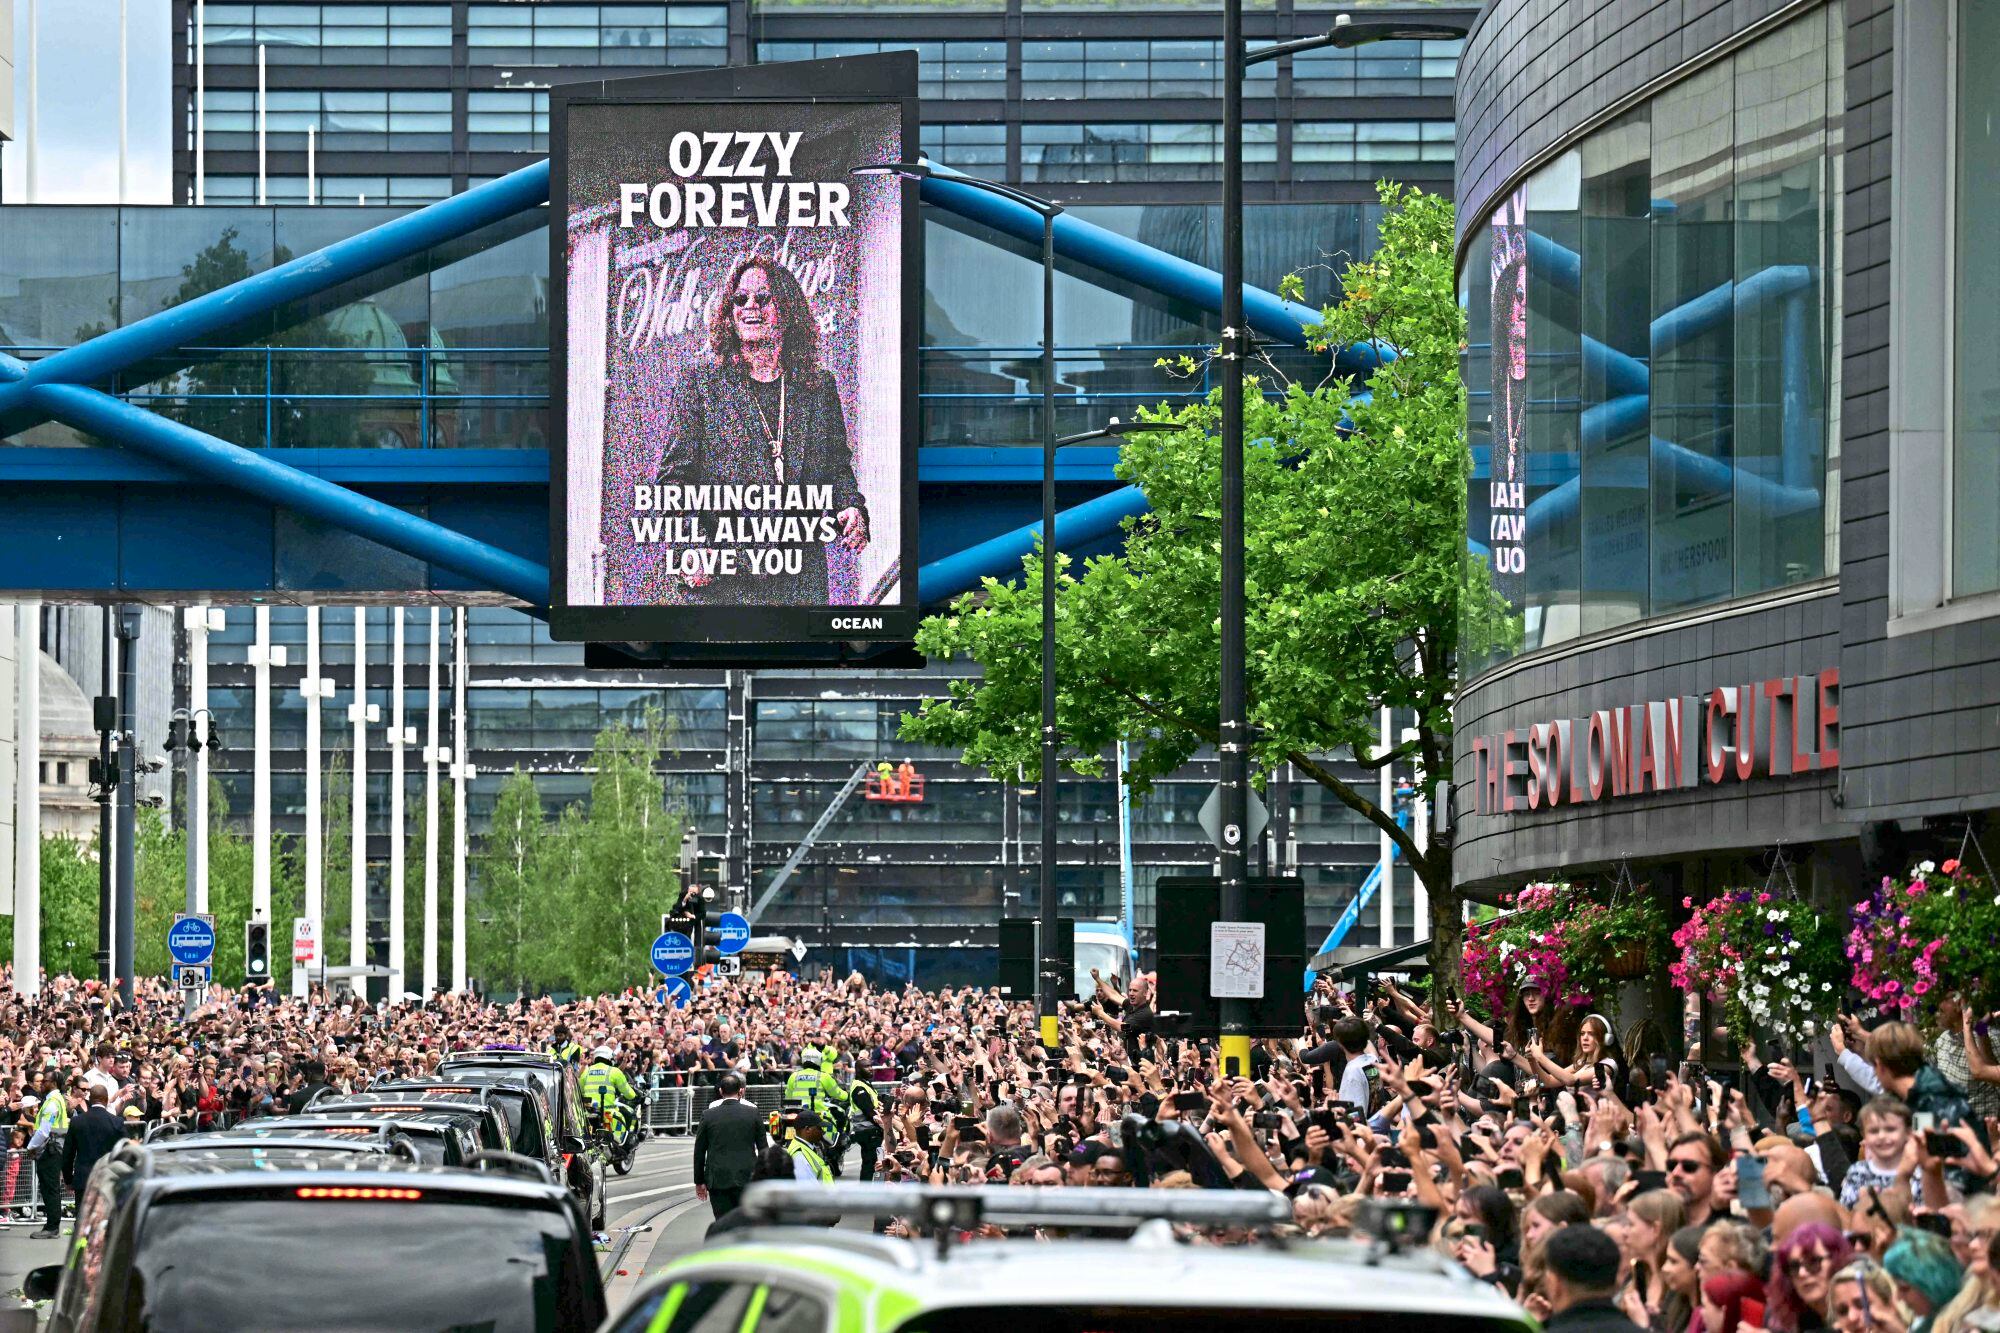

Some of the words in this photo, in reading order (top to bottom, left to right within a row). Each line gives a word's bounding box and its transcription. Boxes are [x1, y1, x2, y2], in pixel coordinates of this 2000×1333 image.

[669, 131, 803, 178] OZZY
[619, 182, 851, 228] FOREVER
[634, 484, 833, 511] BIRMINGHAM
[631, 516, 706, 543] WILL
[714, 516, 837, 543] ALWAYS
[666, 549, 736, 575] LOVE
[745, 549, 803, 575] YOU
[831, 617, 883, 630] OCEAN
[1473, 728, 1528, 816] THE
[1528, 696, 1698, 810] SOLOMAN
[184, 951, 199, 959] taxi
